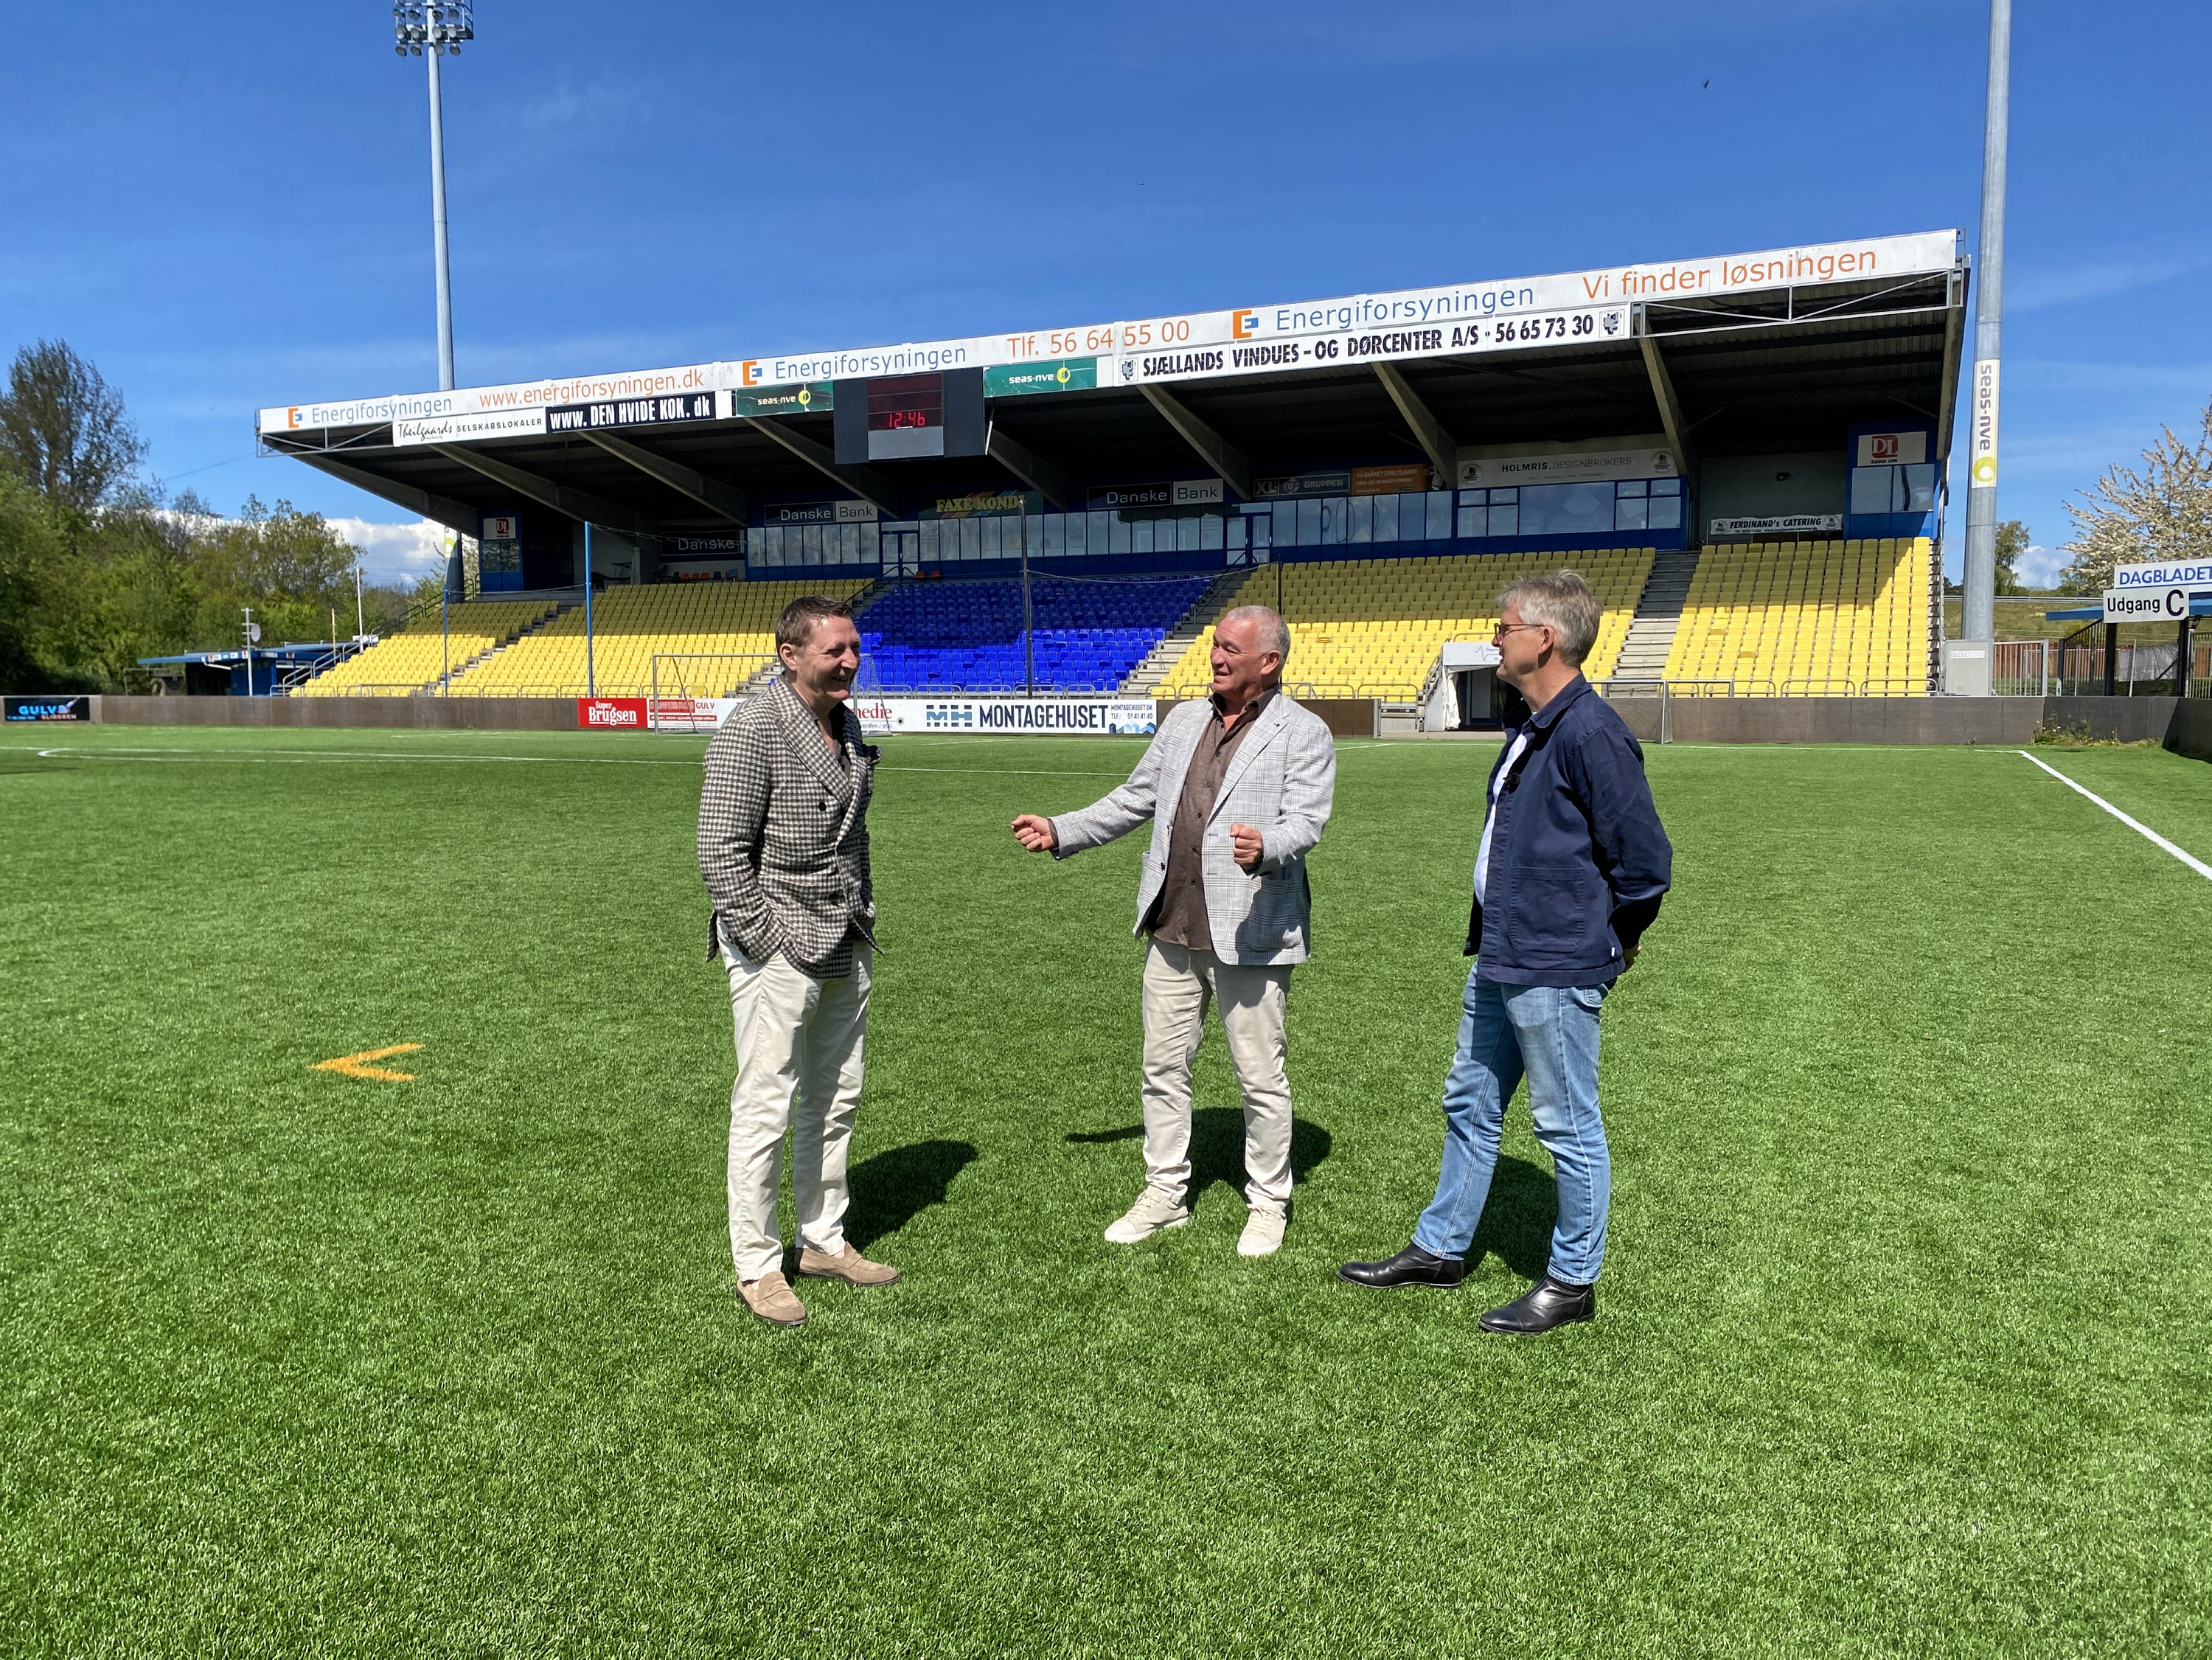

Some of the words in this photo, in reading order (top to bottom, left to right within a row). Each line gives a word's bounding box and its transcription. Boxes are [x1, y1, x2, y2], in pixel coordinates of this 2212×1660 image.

[1582, 274, 1609, 299] Vi
[1621, 266, 1711, 296] finder
[1722, 249, 1877, 287] løsningen
[1276, 286, 1534, 333] Energiforsyningen
[1007, 334, 1040, 358] Tlf.
[1050, 332, 1077, 355] 56
[1086, 329, 1114, 352] 64
[1123, 324, 1150, 347] 55
[1162, 320, 1190, 344] 00
[1142, 349, 1224, 378] SJÆLLANDS
[1232, 343, 1300, 368] VINDUES
[1315, 340, 1339, 361] OG
[1347, 328, 1443, 358] DØRCENTER
[1452, 324, 1479, 347] A/S
[1495, 322, 1517, 343] 56
[1520, 319, 1542, 340] 65
[1545, 316, 1568, 338] 73
[1571, 315, 1594, 336] 30
[774, 344, 967, 380] Energiforsyningen
[479, 368, 704, 409] www.energiforsyningen.dk
[1008, 371, 1054, 385] seas-nve
[311, 395, 453, 425] Energiforsyningen
[591, 406, 615, 425] DEN
[618, 401, 655, 423] HVIDE
[658, 398, 691, 419] KOK.
[693, 396, 711, 417] dk
[757, 393, 796, 406] seas-nve
[1979, 364, 1992, 451] seas-nve
[398, 420, 453, 442] Theilgaards
[456, 418, 543, 433] SELSKABSLOKALER
[888, 410, 925, 428] 12:46
[1107, 489, 1167, 504] Danske
[1177, 485, 1219, 500] Bank
[1304, 479, 1344, 489] GRUPPEN
[780, 507, 831, 521] Danske
[839, 505, 874, 518] Bank
[936, 498, 973, 513] FAXE
[1730, 518, 1780, 529] FERDINAND's
[1783, 518, 1822, 527] CATERING
[678, 537, 734, 550] Danske
[2107, 597, 2160, 614] Udgang
[2166, 588, 2185, 617] C
[18, 705, 58, 715] GULV
[588, 706, 637, 726] Brugsen
[595, 701, 613, 711] Super
[979, 704, 1108, 729] MONTAGEHUSET
